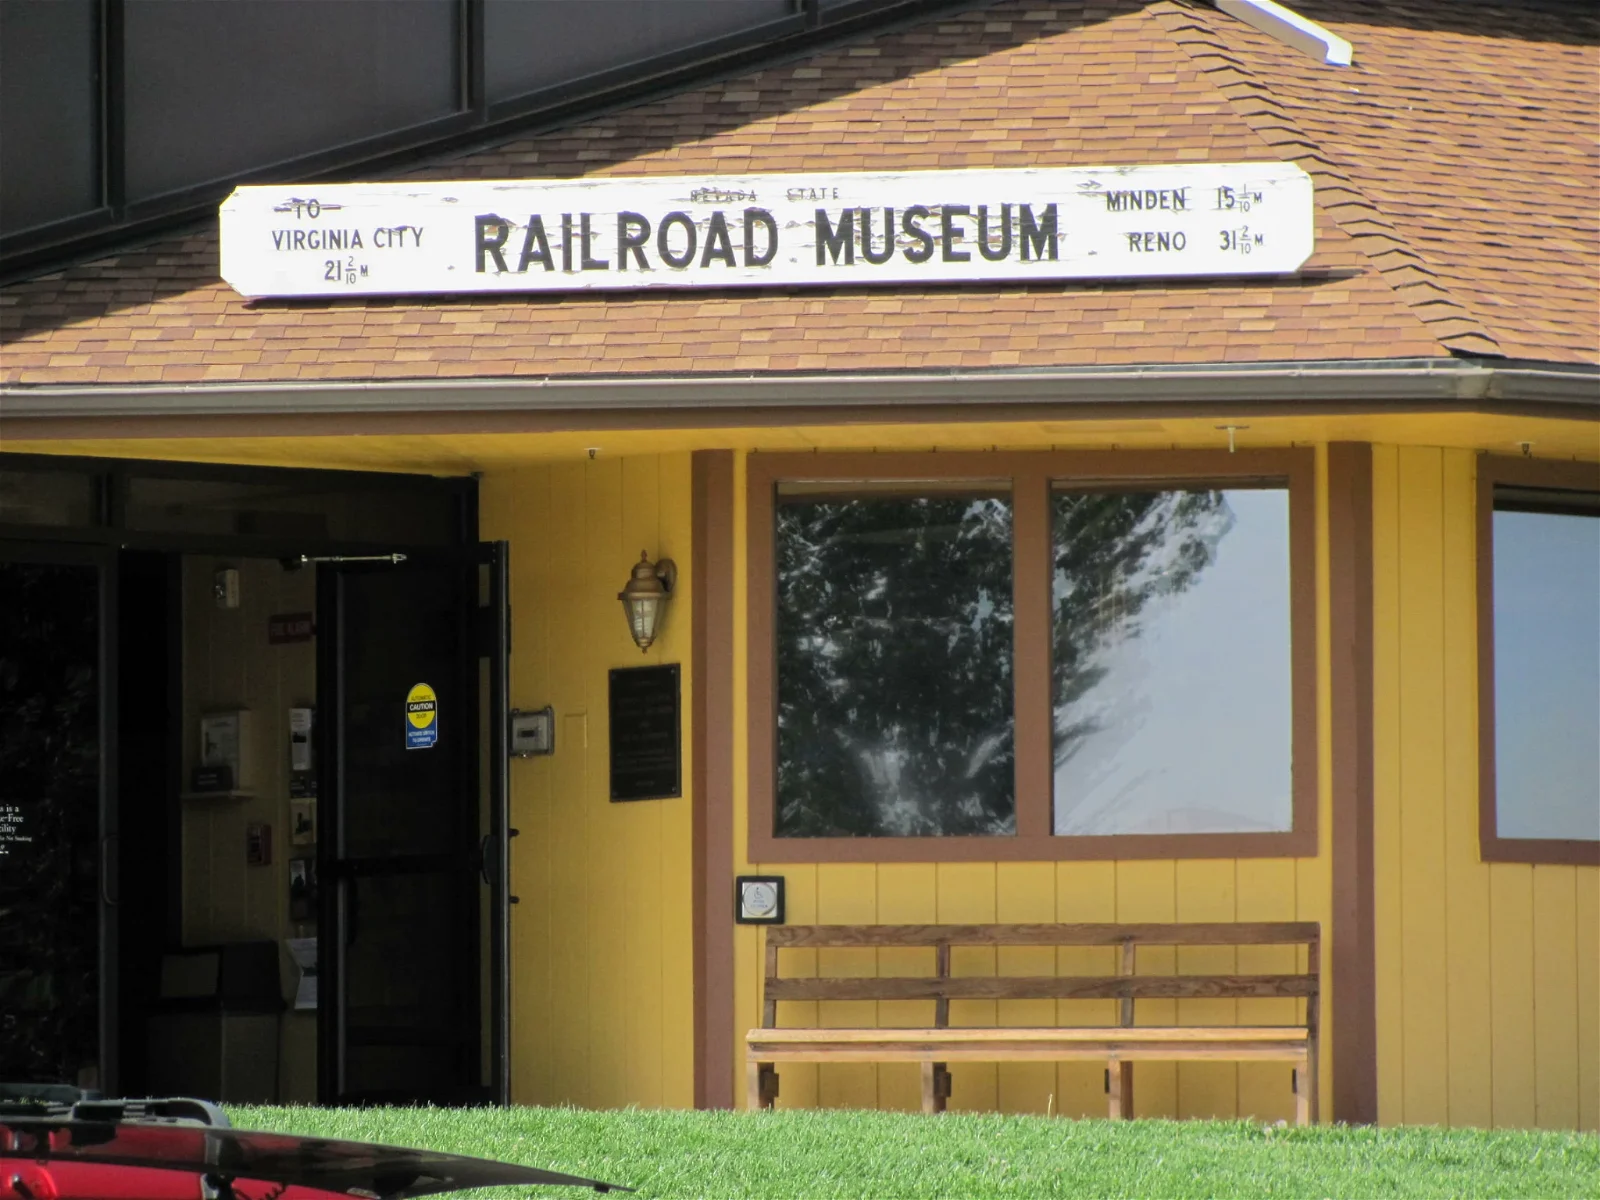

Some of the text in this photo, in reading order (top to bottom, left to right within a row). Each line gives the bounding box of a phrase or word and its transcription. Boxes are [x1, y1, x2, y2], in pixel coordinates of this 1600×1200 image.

[787, 187, 839, 201] STATE
[1106, 188, 1186, 211] MINDEN
[272, 226, 424, 251] VIRGINIA CITY
[474, 203, 1059, 273] RAILROAD MUSEUM
[1129, 231, 1187, 252] RENO
[1219, 230, 1236, 250] 31
[324, 260, 342, 281] 21
[409, 703, 434, 711] CAUTION
[0, 813, 24, 822] e-Free
